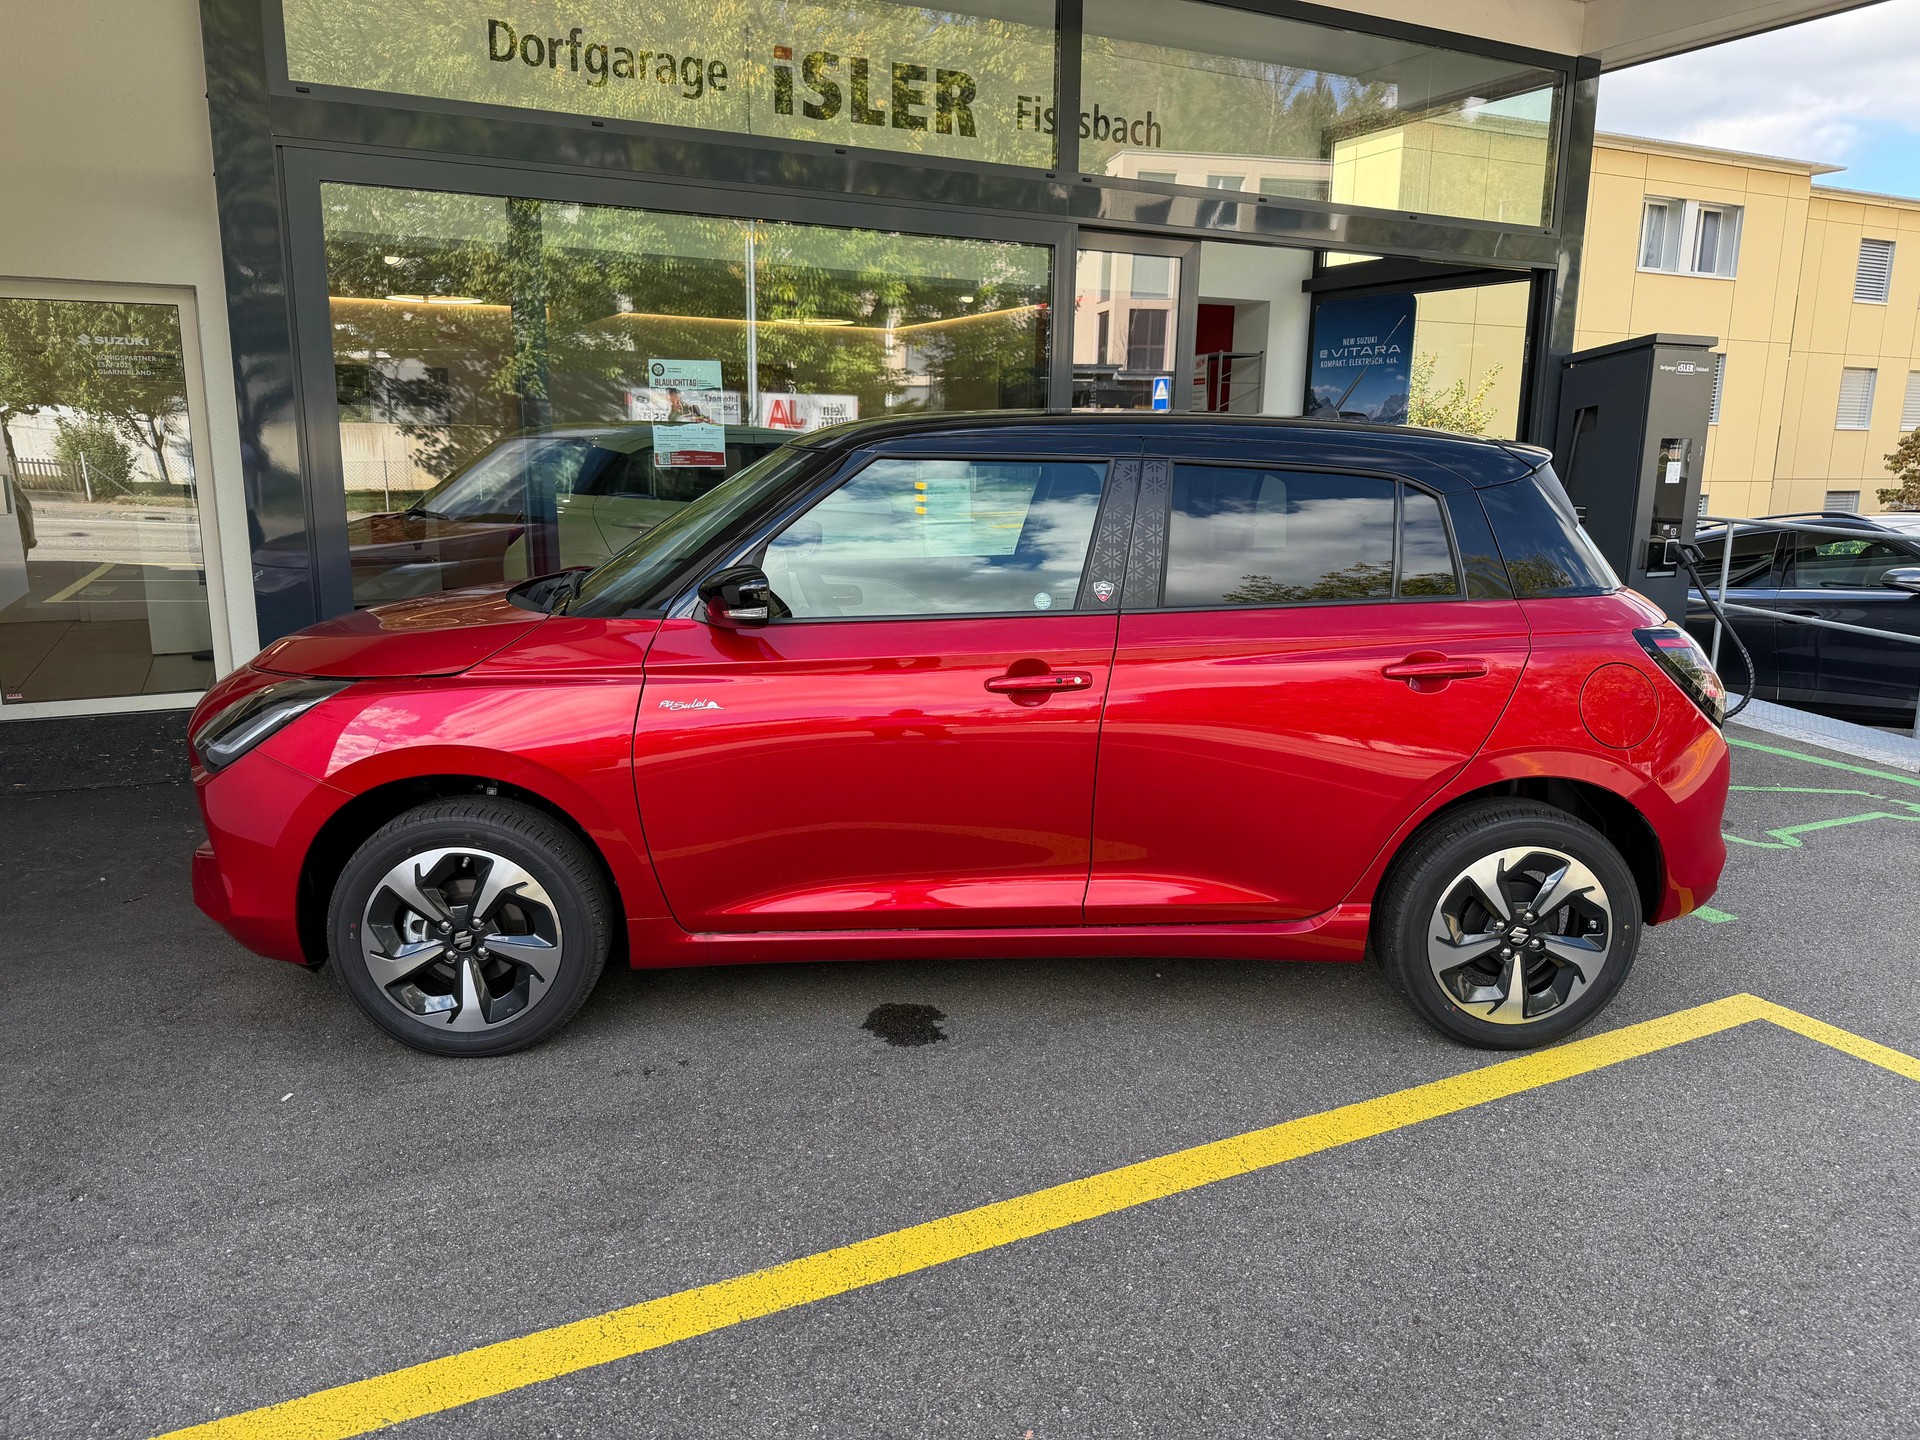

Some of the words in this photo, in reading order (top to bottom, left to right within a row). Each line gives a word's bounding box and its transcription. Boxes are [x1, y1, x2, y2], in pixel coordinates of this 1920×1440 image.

[487, 18, 728, 100] Dorfgarage
[1016, 95, 1161, 148] Fissbach
[93, 336, 150, 346] SUZUKI
[1342, 338, 1355, 346] NEW
[1356, 336, 1378, 345] SUZUKI
[1331, 344, 1401, 358] VITARA
[1320, 359, 1347, 368] KOMPAKT.
[654, 378, 697, 387] BLAULICHTTAG
